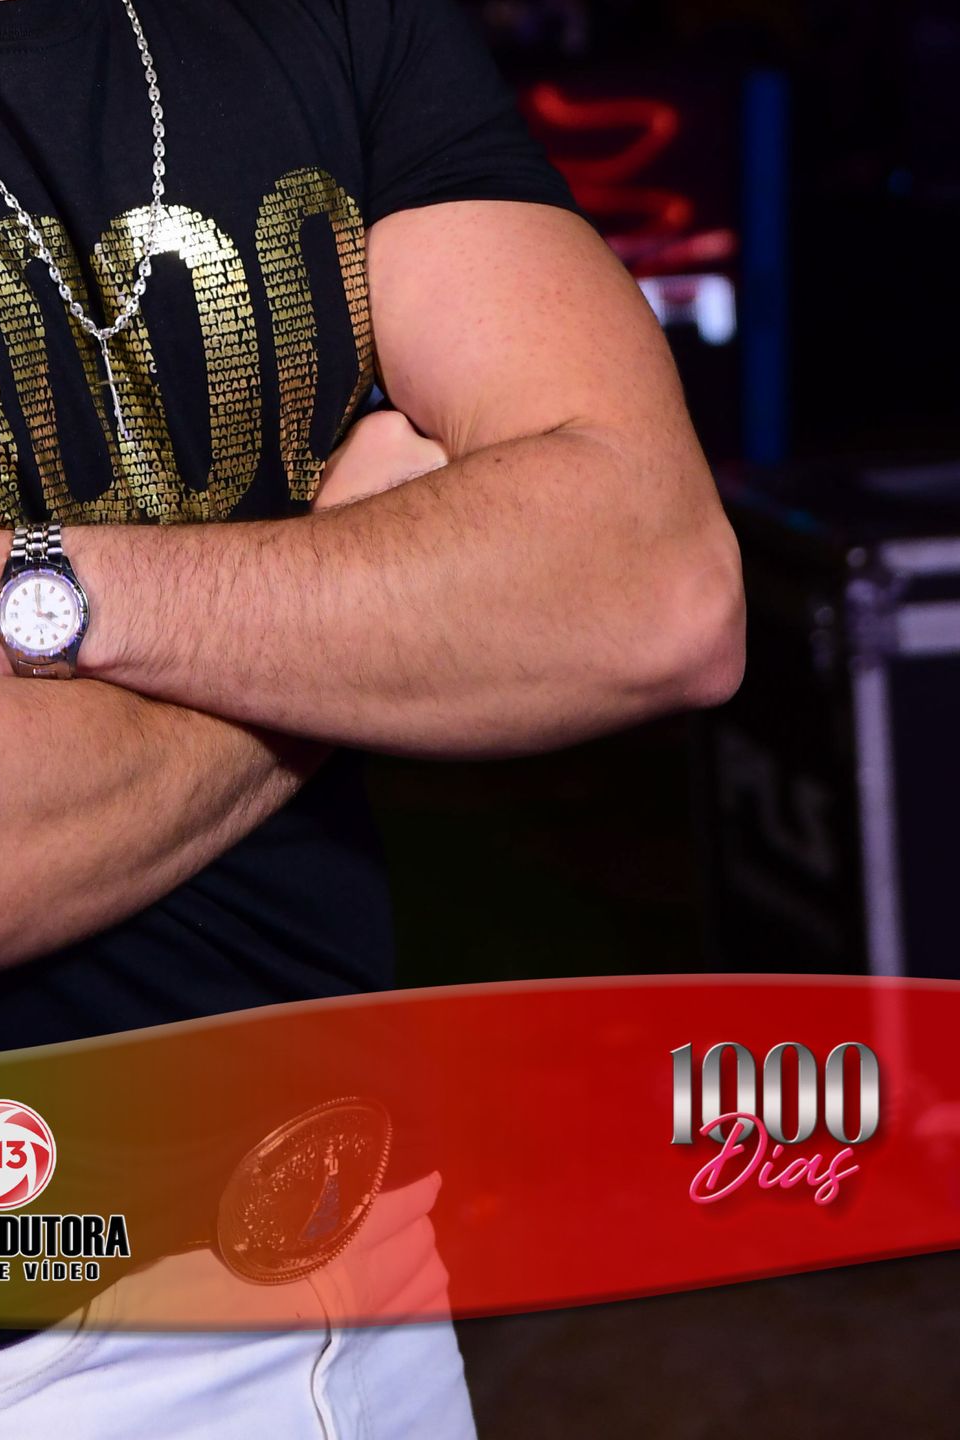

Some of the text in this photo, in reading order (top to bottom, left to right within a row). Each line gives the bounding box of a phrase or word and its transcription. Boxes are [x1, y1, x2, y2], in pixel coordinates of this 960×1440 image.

[191, 261, 225, 279] ANNA
[192, 272, 227, 291] DUDA
[207, 378, 248, 395] LUCAS
